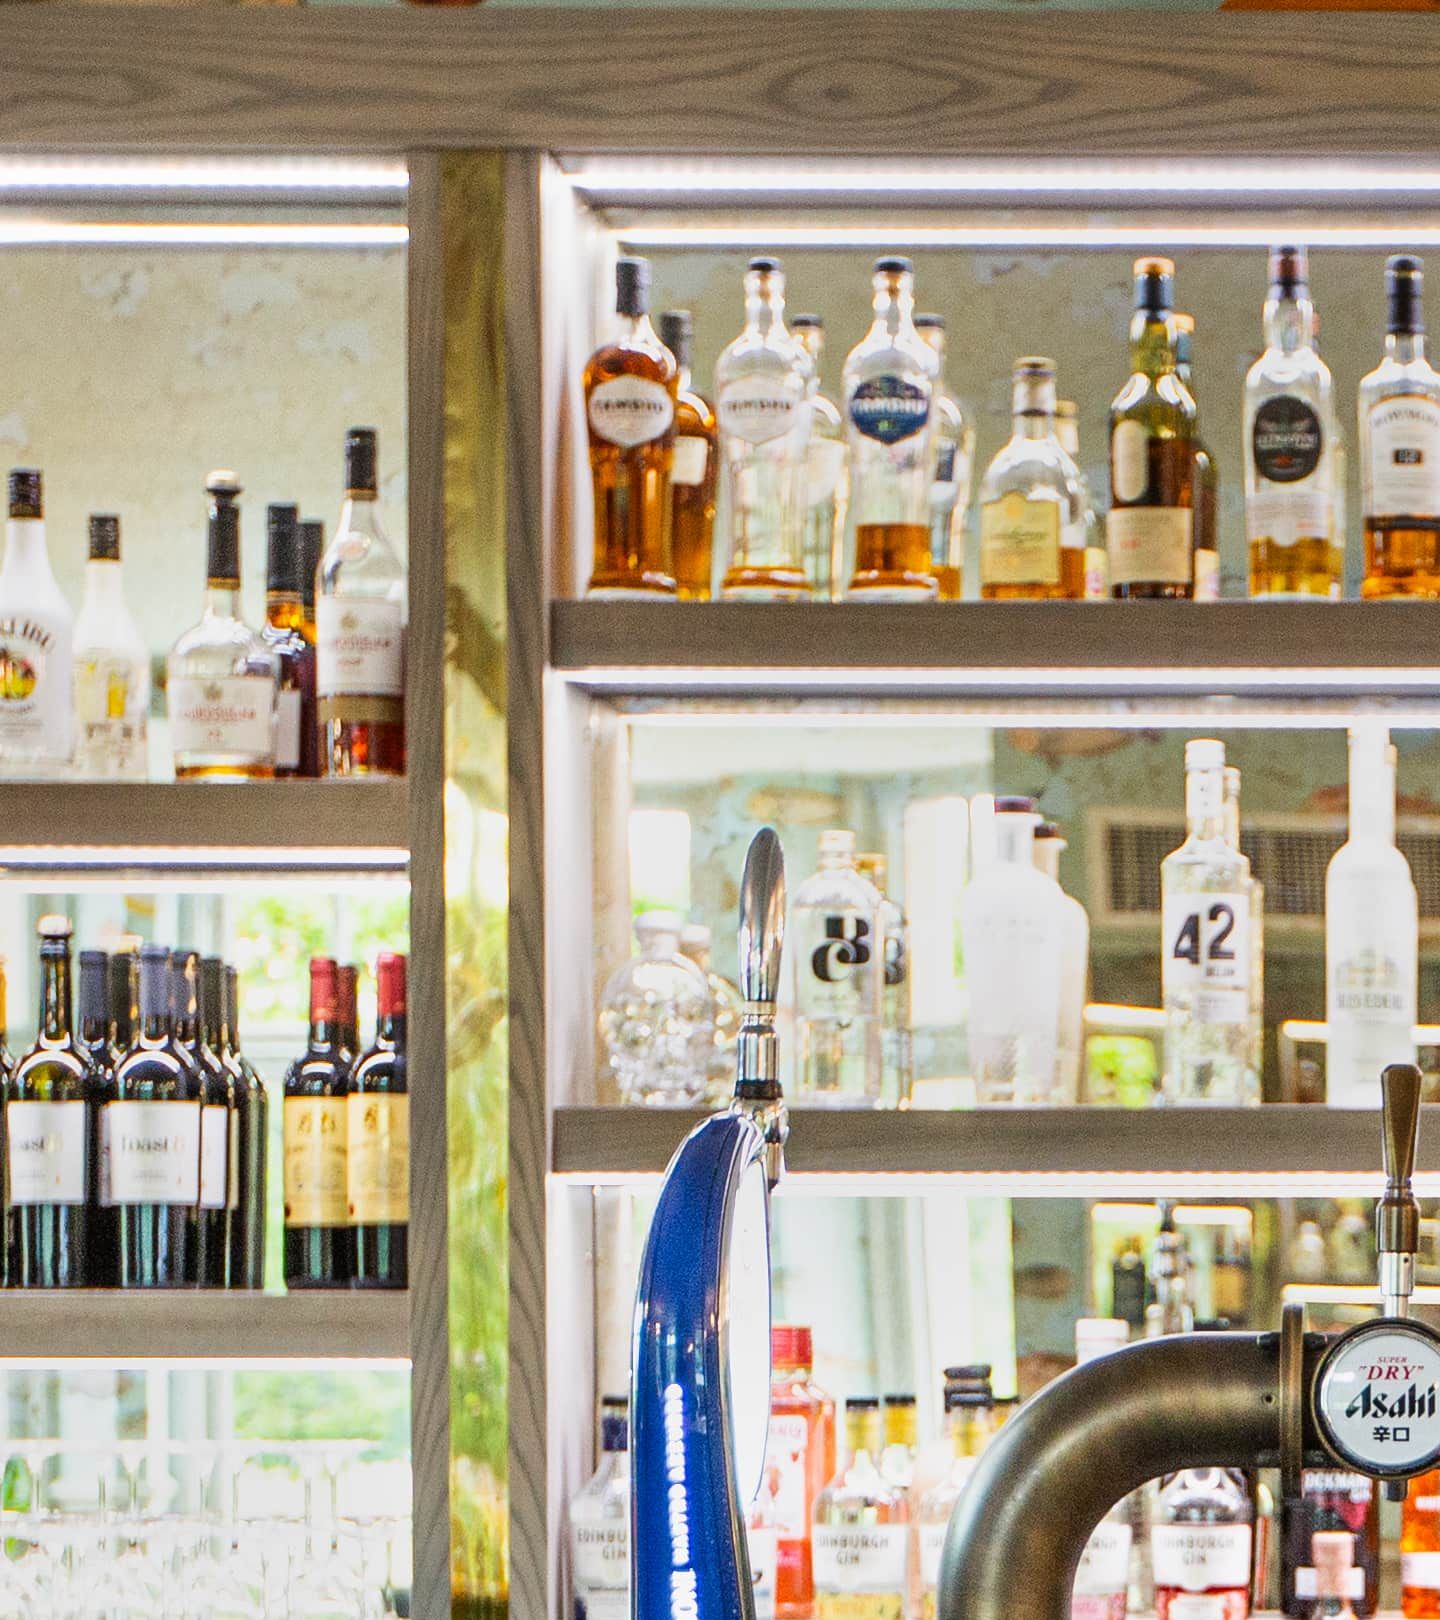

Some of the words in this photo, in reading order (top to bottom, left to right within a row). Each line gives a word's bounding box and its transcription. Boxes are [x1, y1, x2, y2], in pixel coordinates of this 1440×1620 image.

[1172, 901, 1235, 967] 42
[1345, 1382, 1437, 1419] Asahi
[1371, 1425, 1410, 1442] 辛口
